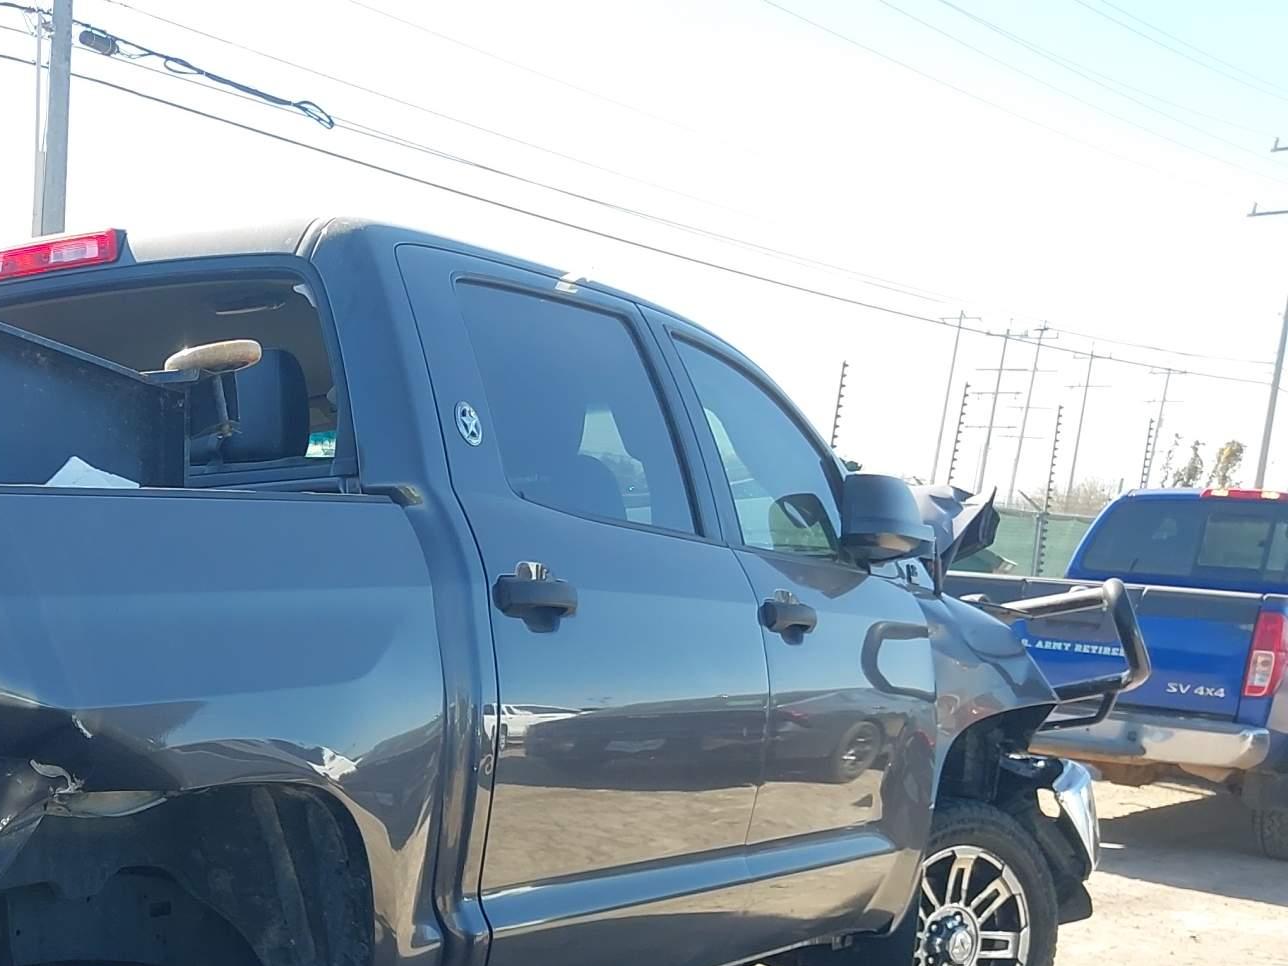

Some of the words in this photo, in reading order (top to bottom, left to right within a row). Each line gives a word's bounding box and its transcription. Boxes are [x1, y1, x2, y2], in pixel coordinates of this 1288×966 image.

[1033, 639, 1071, 651] ARMY
[1165, 682, 1191, 694] SV
[1193, 685, 1225, 698] 4x4
